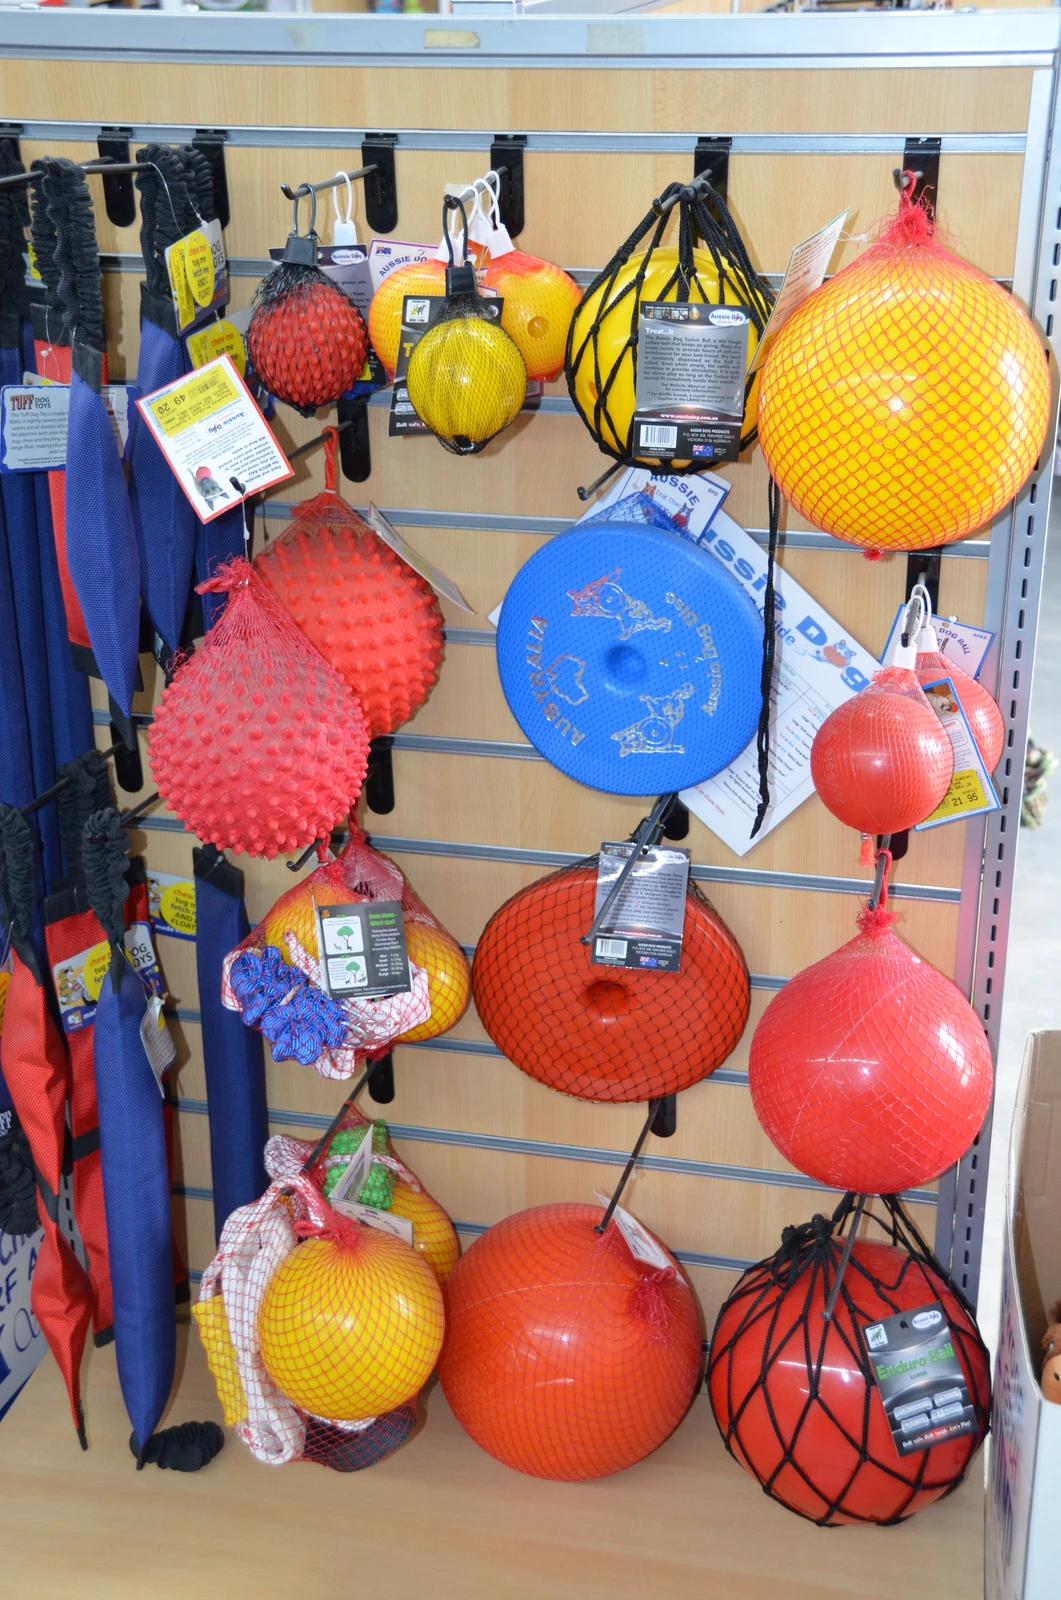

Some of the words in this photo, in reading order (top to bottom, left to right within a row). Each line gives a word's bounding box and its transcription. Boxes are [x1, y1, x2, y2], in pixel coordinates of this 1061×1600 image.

[189, 247, 198, 256] chew
[212, 241, 221, 254] OG
[214, 256, 225, 267] OYS
[379, 256, 411, 276] AUSSIE
[193, 269, 202, 278] fetch
[731, 313, 743, 321] Dog
[212, 336, 225, 347] chew
[226, 332, 234, 340] me
[216, 347, 225, 355] tug
[10, 394, 34, 410] TUFF
[222, 410, 245, 427] Aussie
[660, 413, 718, 421] www.aussiedog.com.au
[207, 422, 222, 435] Dog
[650, 475, 700, 506] AUSSIE
[656, 490, 669, 501] Dog
[664, 591, 700, 627] Disc
[696, 623, 719, 659] Dog
[939, 628, 957, 639] DOG
[957, 639, 970, 654] BALL
[526, 615, 586, 746] AUSTRALIA
[701, 661, 722, 717] Aussie
[800, 714, 810, 723] Large
[954, 773, 972, 782] Saddlery
[951, 791, 978, 806] 21.95
[174, 889, 194, 899] chew
[170, 903, 190, 913] fetch
[175, 898, 188, 908] tug
[174, 912, 192, 922] AND
[131, 944, 147, 956] OG
[89, 955, 106, 968] chew
[133, 953, 152, 968] OYS
[95, 965, 106, 974] tug
[83, 1009, 96, 1020] mad
[912, 1315, 928, 1324] Aussie
[928, 1311, 939, 1320] Dog
[875, 1352, 927, 1380] Enduro
[926, 1342, 954, 1363] Ball
[936, 1409, 944, 1417] 12
[902, 1439, 912, 1447] Built
[912, 1435, 924, 1443] safe,
[923, 1431, 934, 1439] Built
[934, 1427, 947, 1436] tough
[949, 1423, 960, 1431] Let's
